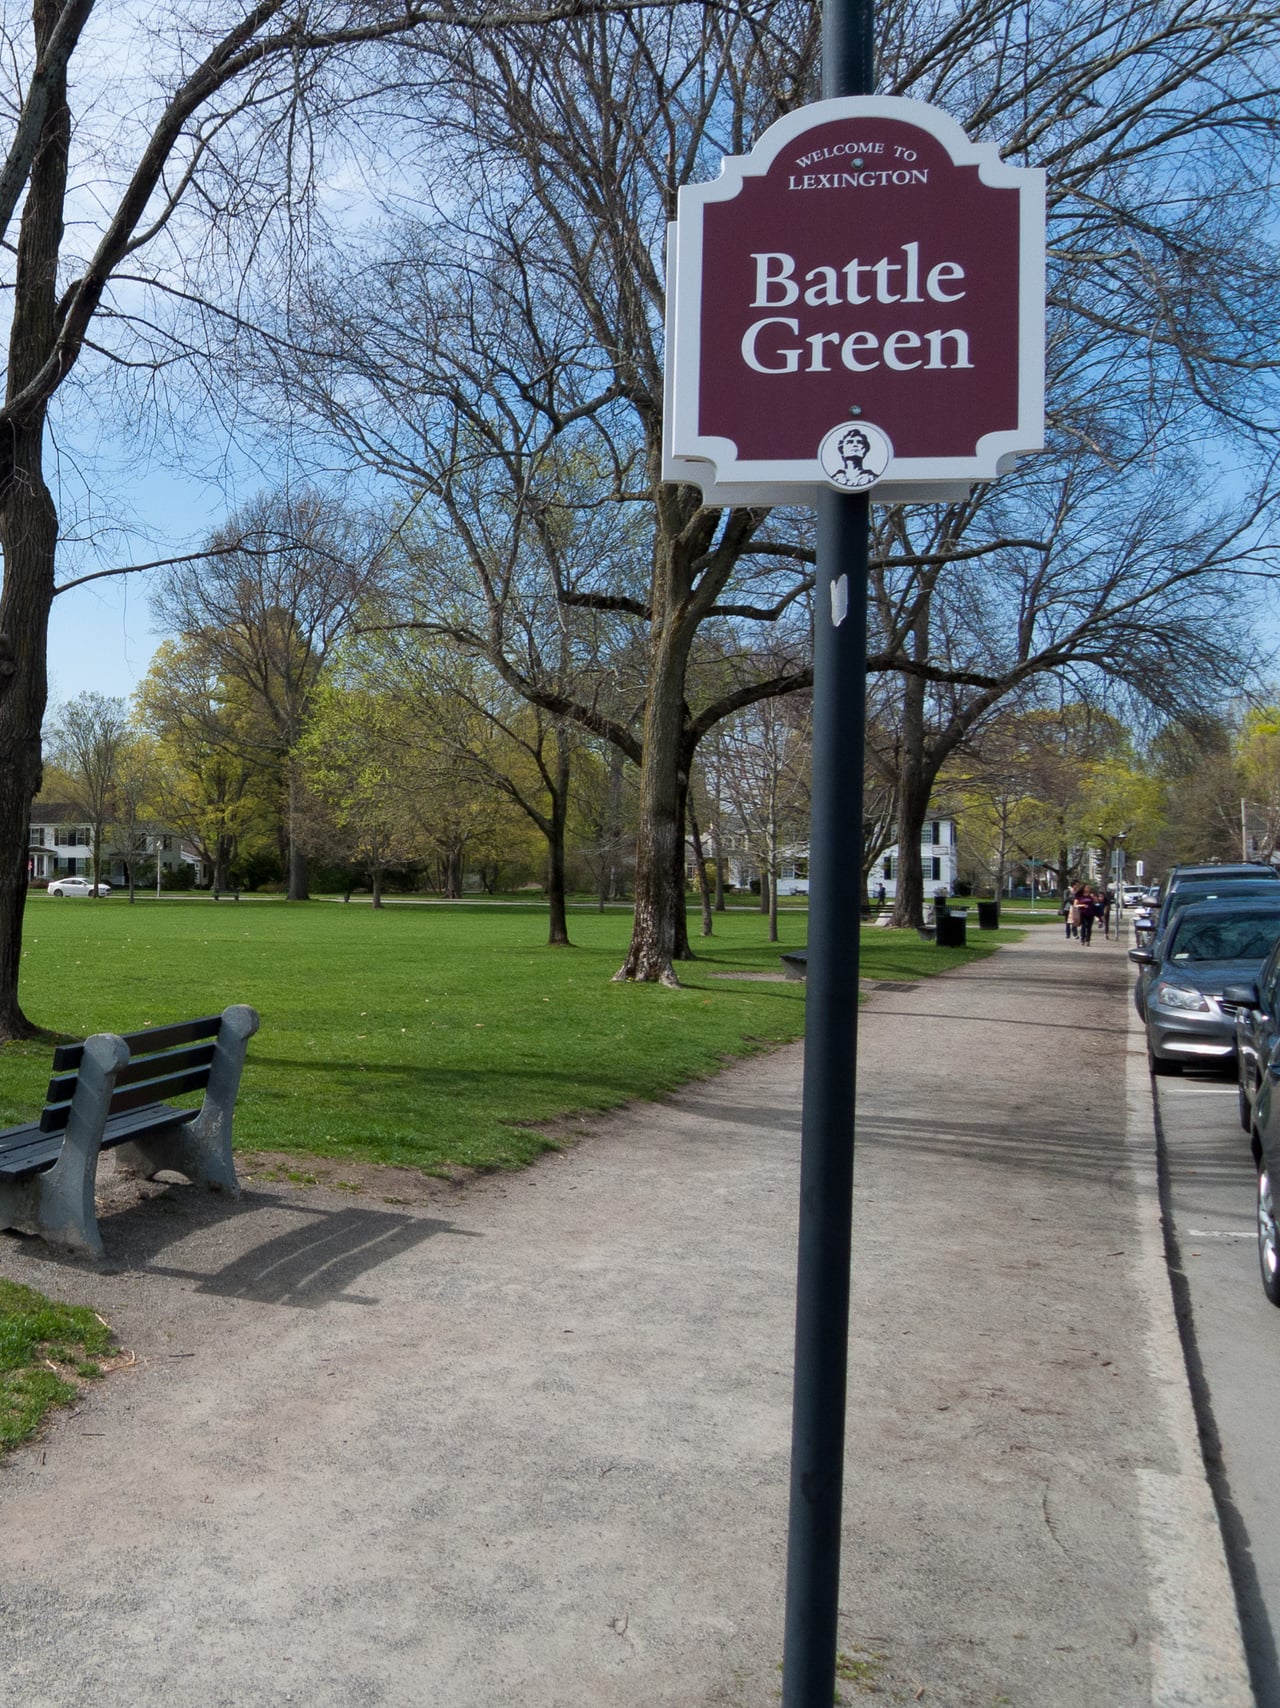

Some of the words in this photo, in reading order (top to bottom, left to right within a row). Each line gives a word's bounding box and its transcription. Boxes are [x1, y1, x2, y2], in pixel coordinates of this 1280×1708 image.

[795, 142, 885, 168] WELCOME
[893, 145, 917, 162] TO
[788, 169, 929, 190] LEXINGTON
[749, 241, 966, 308] Battle
[740, 317, 975, 374] Green
